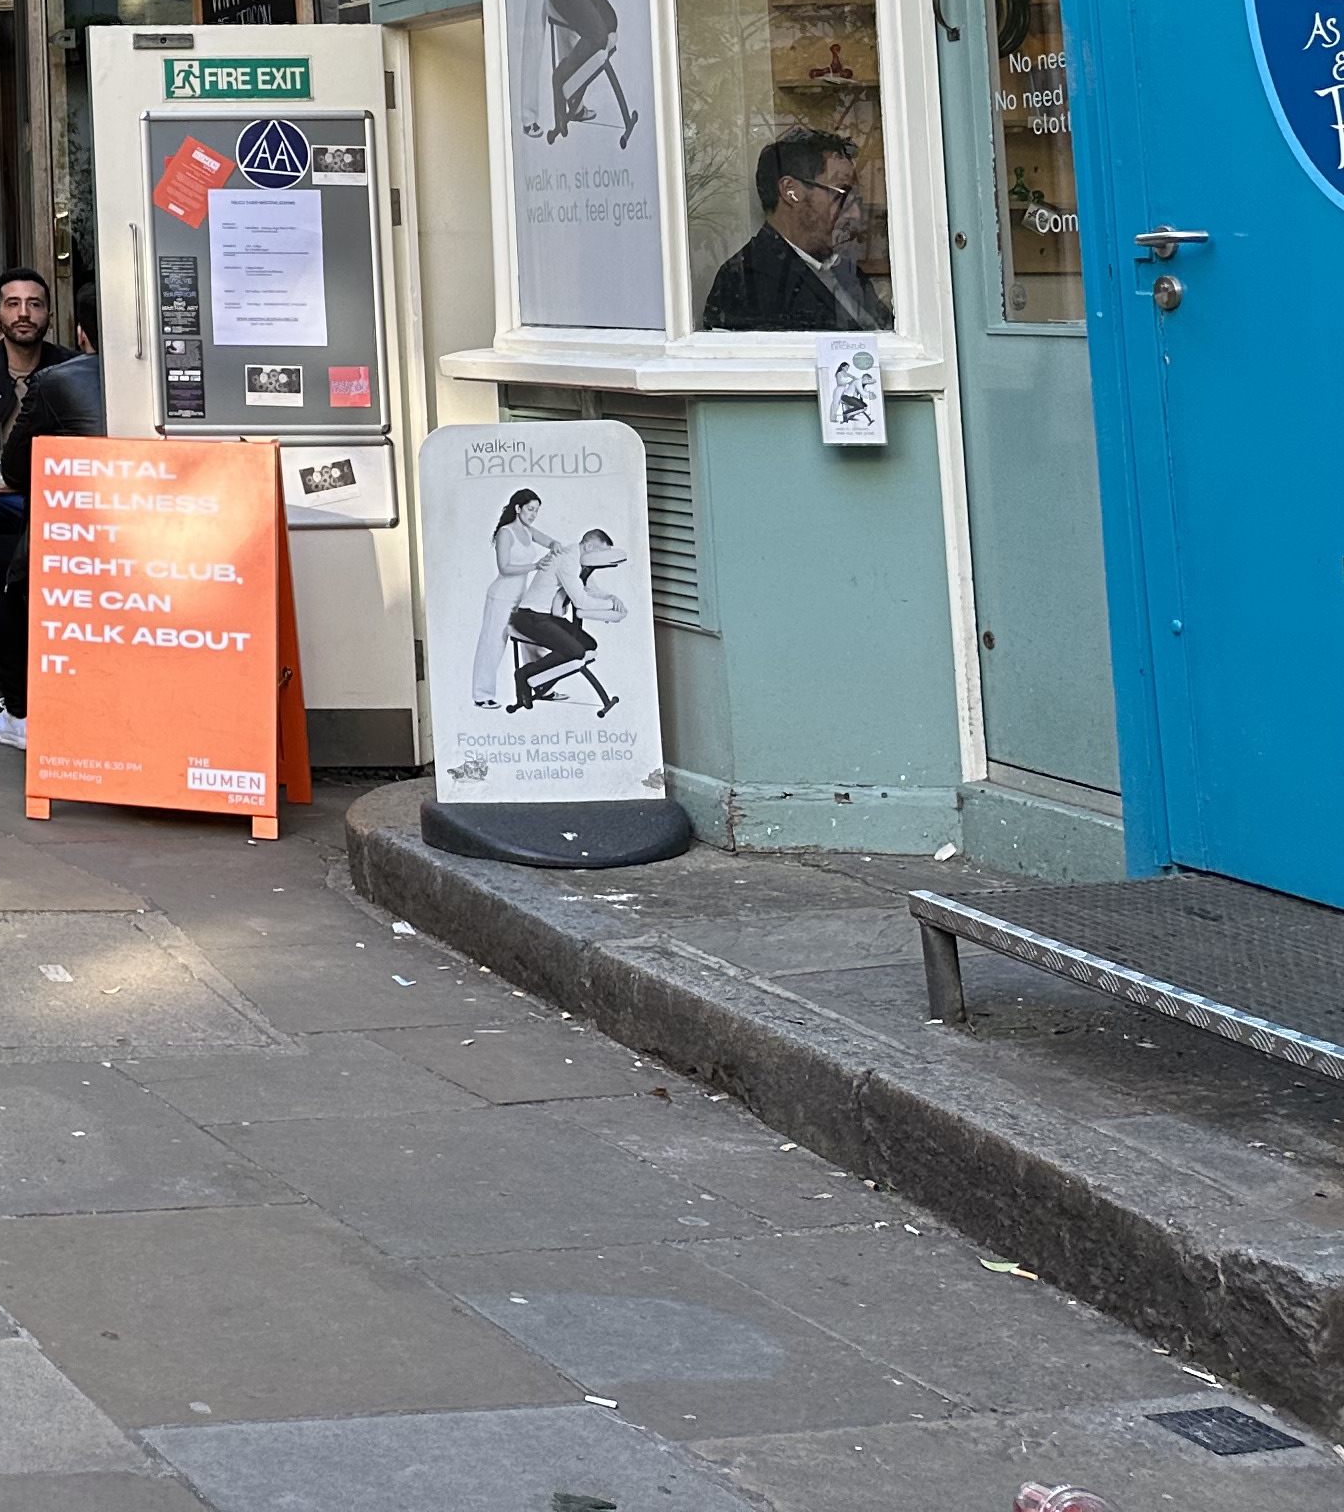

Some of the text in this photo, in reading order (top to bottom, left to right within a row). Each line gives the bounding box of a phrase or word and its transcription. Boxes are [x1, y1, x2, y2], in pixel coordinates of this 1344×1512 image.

[1302, 12, 1340, 51] AS
[1009, 52, 1031, 73] No
[205, 67, 304, 90] FIRE EXIT
[995, 86, 1063, 111] No need
[255, 139, 290, 171] AA
[525, 168, 552, 192] walk
[575, 167, 590, 189] sit
[593, 165, 634, 190] down,
[527, 200, 554, 223] walk
[585, 198, 608, 221] feel
[613, 198, 652, 227] great.
[471, 439, 526, 453] walk-in
[44, 458, 176, 480] MENTAL
[464, 446, 602, 477] backrub
[44, 490, 219, 514] WELLNESS
[43, 522, 119, 542] ISN'T
[42, 556, 243, 584] FIGHT CLUB,
[42, 589, 170, 612] WE CAN
[42, 621, 250, 651] TALK ABOUT
[41, 654, 76, 674] IT.
[457, 730, 637, 748] Footrubs and Full Body
[39, 756, 70, 766] EVERY
[72, 758, 102, 769] WEEK
[126, 761, 142, 771] PM
[188, 757, 209, 767] THE
[464, 748, 633, 766] Shiatsu Massage also
[192, 772, 261, 790] HUMEN
[515, 765, 584, 780] available
[227, 794, 265, 806] SPACE
